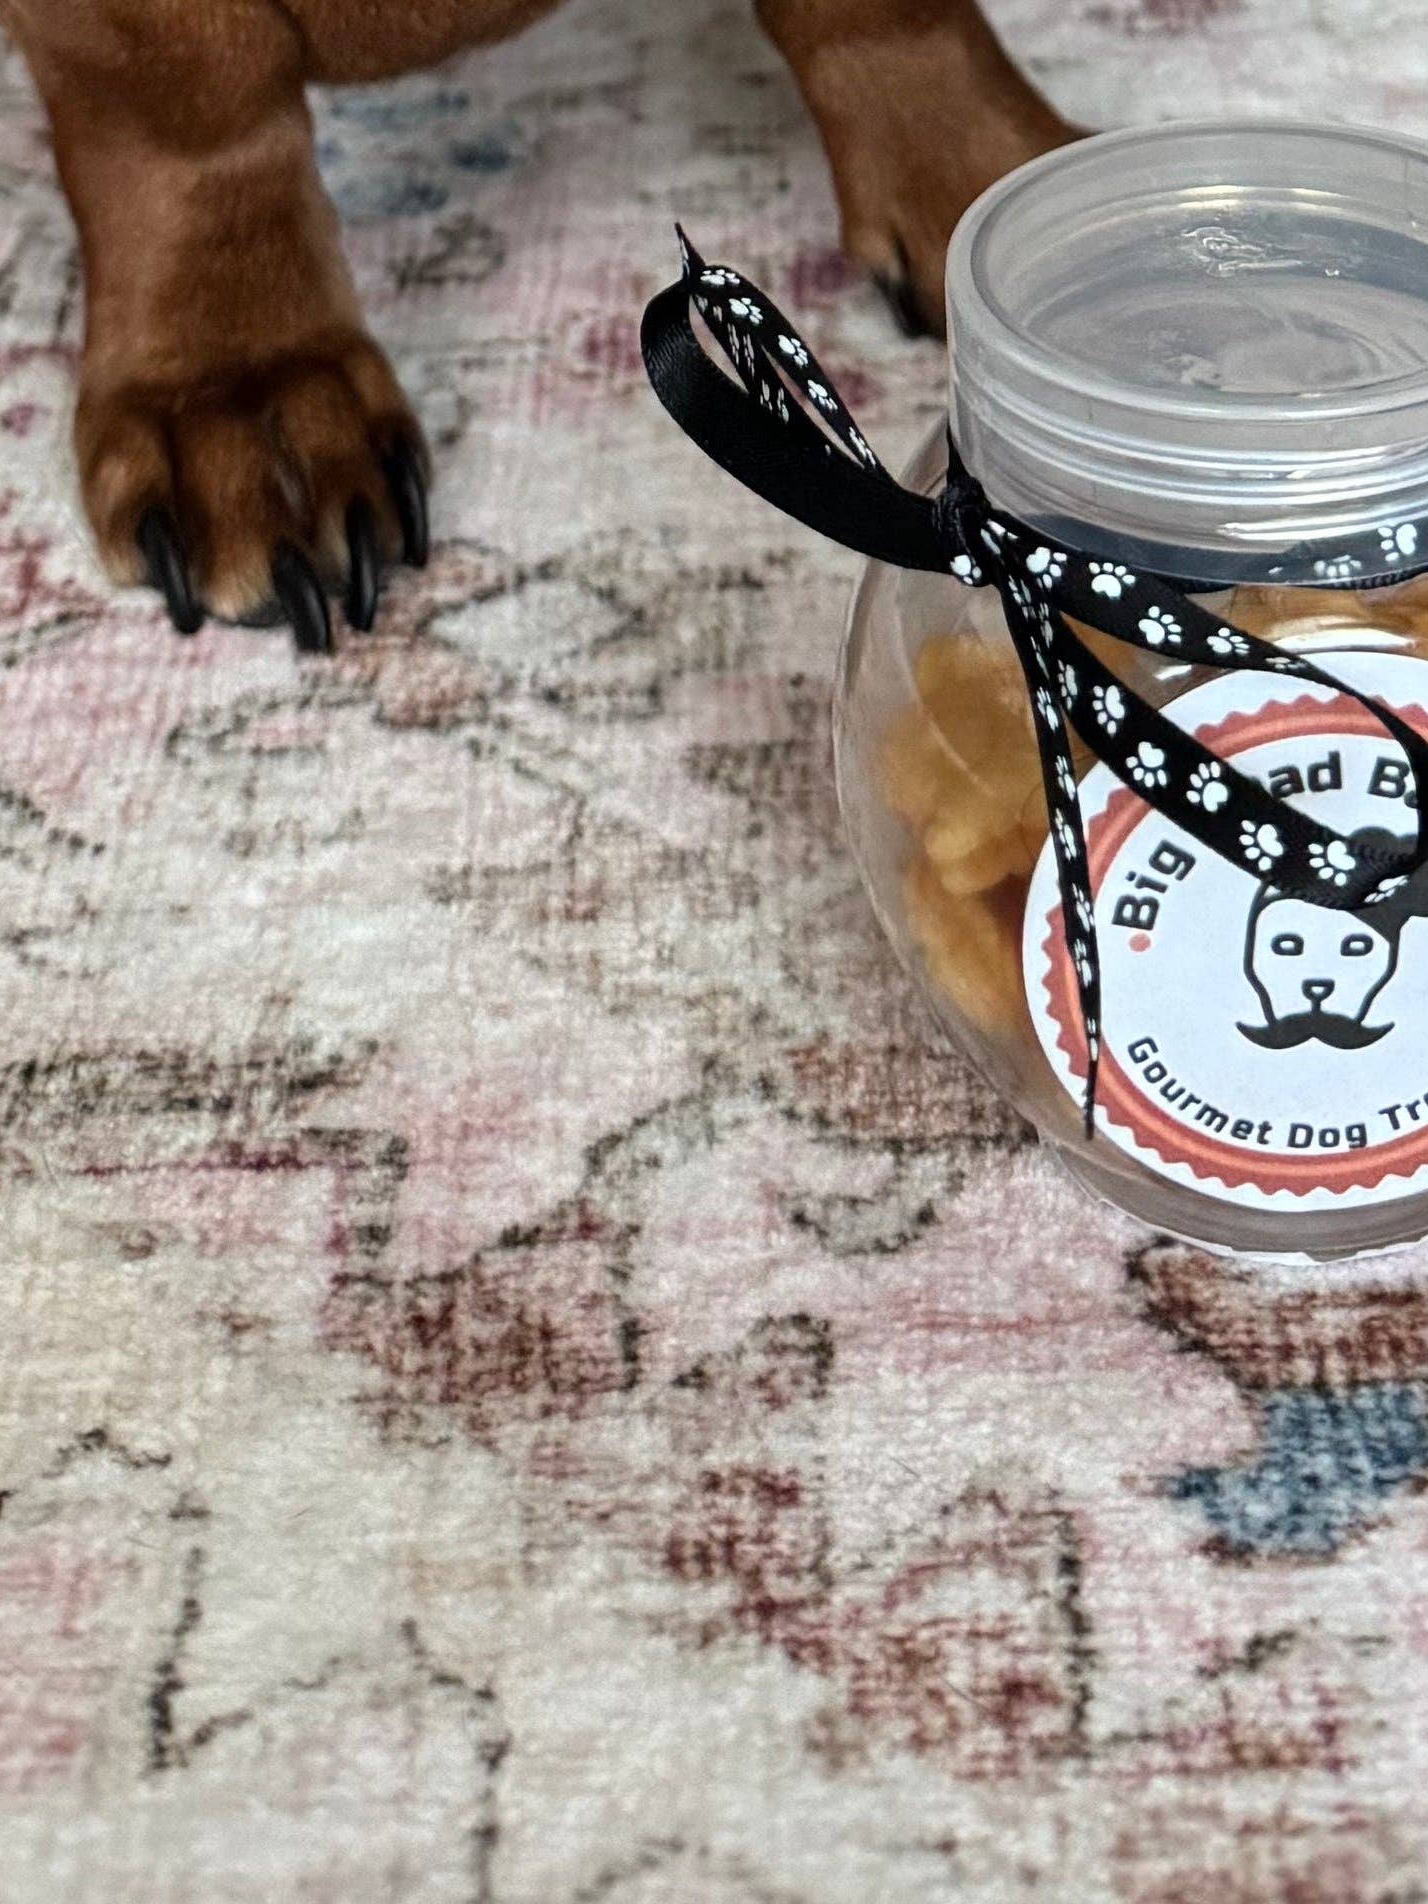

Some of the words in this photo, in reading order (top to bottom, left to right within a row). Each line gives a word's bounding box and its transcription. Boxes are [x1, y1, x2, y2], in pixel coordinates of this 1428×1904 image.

[1112, 838, 1197, 932] Big
[1264, 750, 1343, 800] ad
[1126, 1034, 1274, 1146] Gourmet
[1286, 1122, 1368, 1150] Dog
